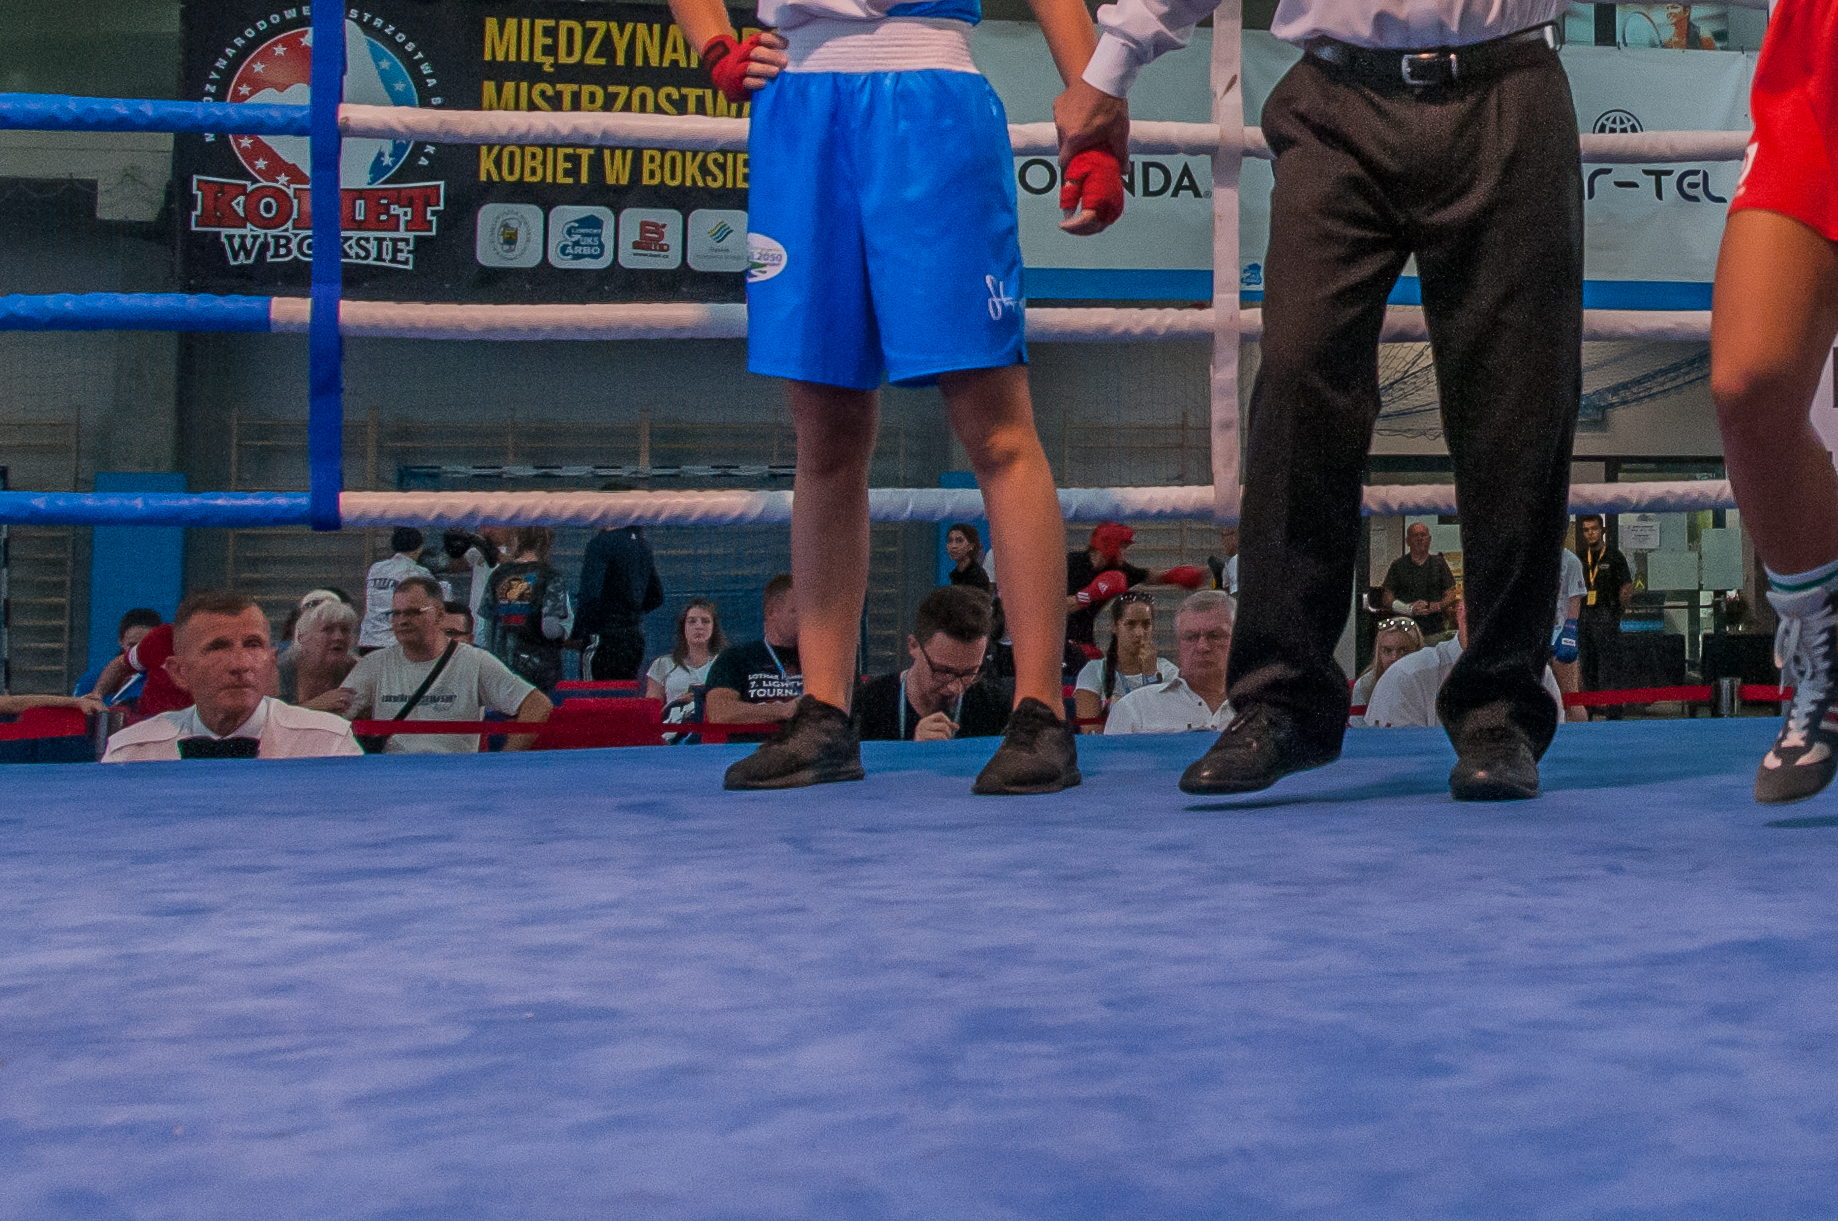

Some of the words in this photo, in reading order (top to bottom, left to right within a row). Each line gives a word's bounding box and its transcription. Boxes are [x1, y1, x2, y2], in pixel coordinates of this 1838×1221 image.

[478, 145, 595, 185] KOBIET
[602, 149, 633, 186] W
[641, 150, 750, 189] BOKSIE
